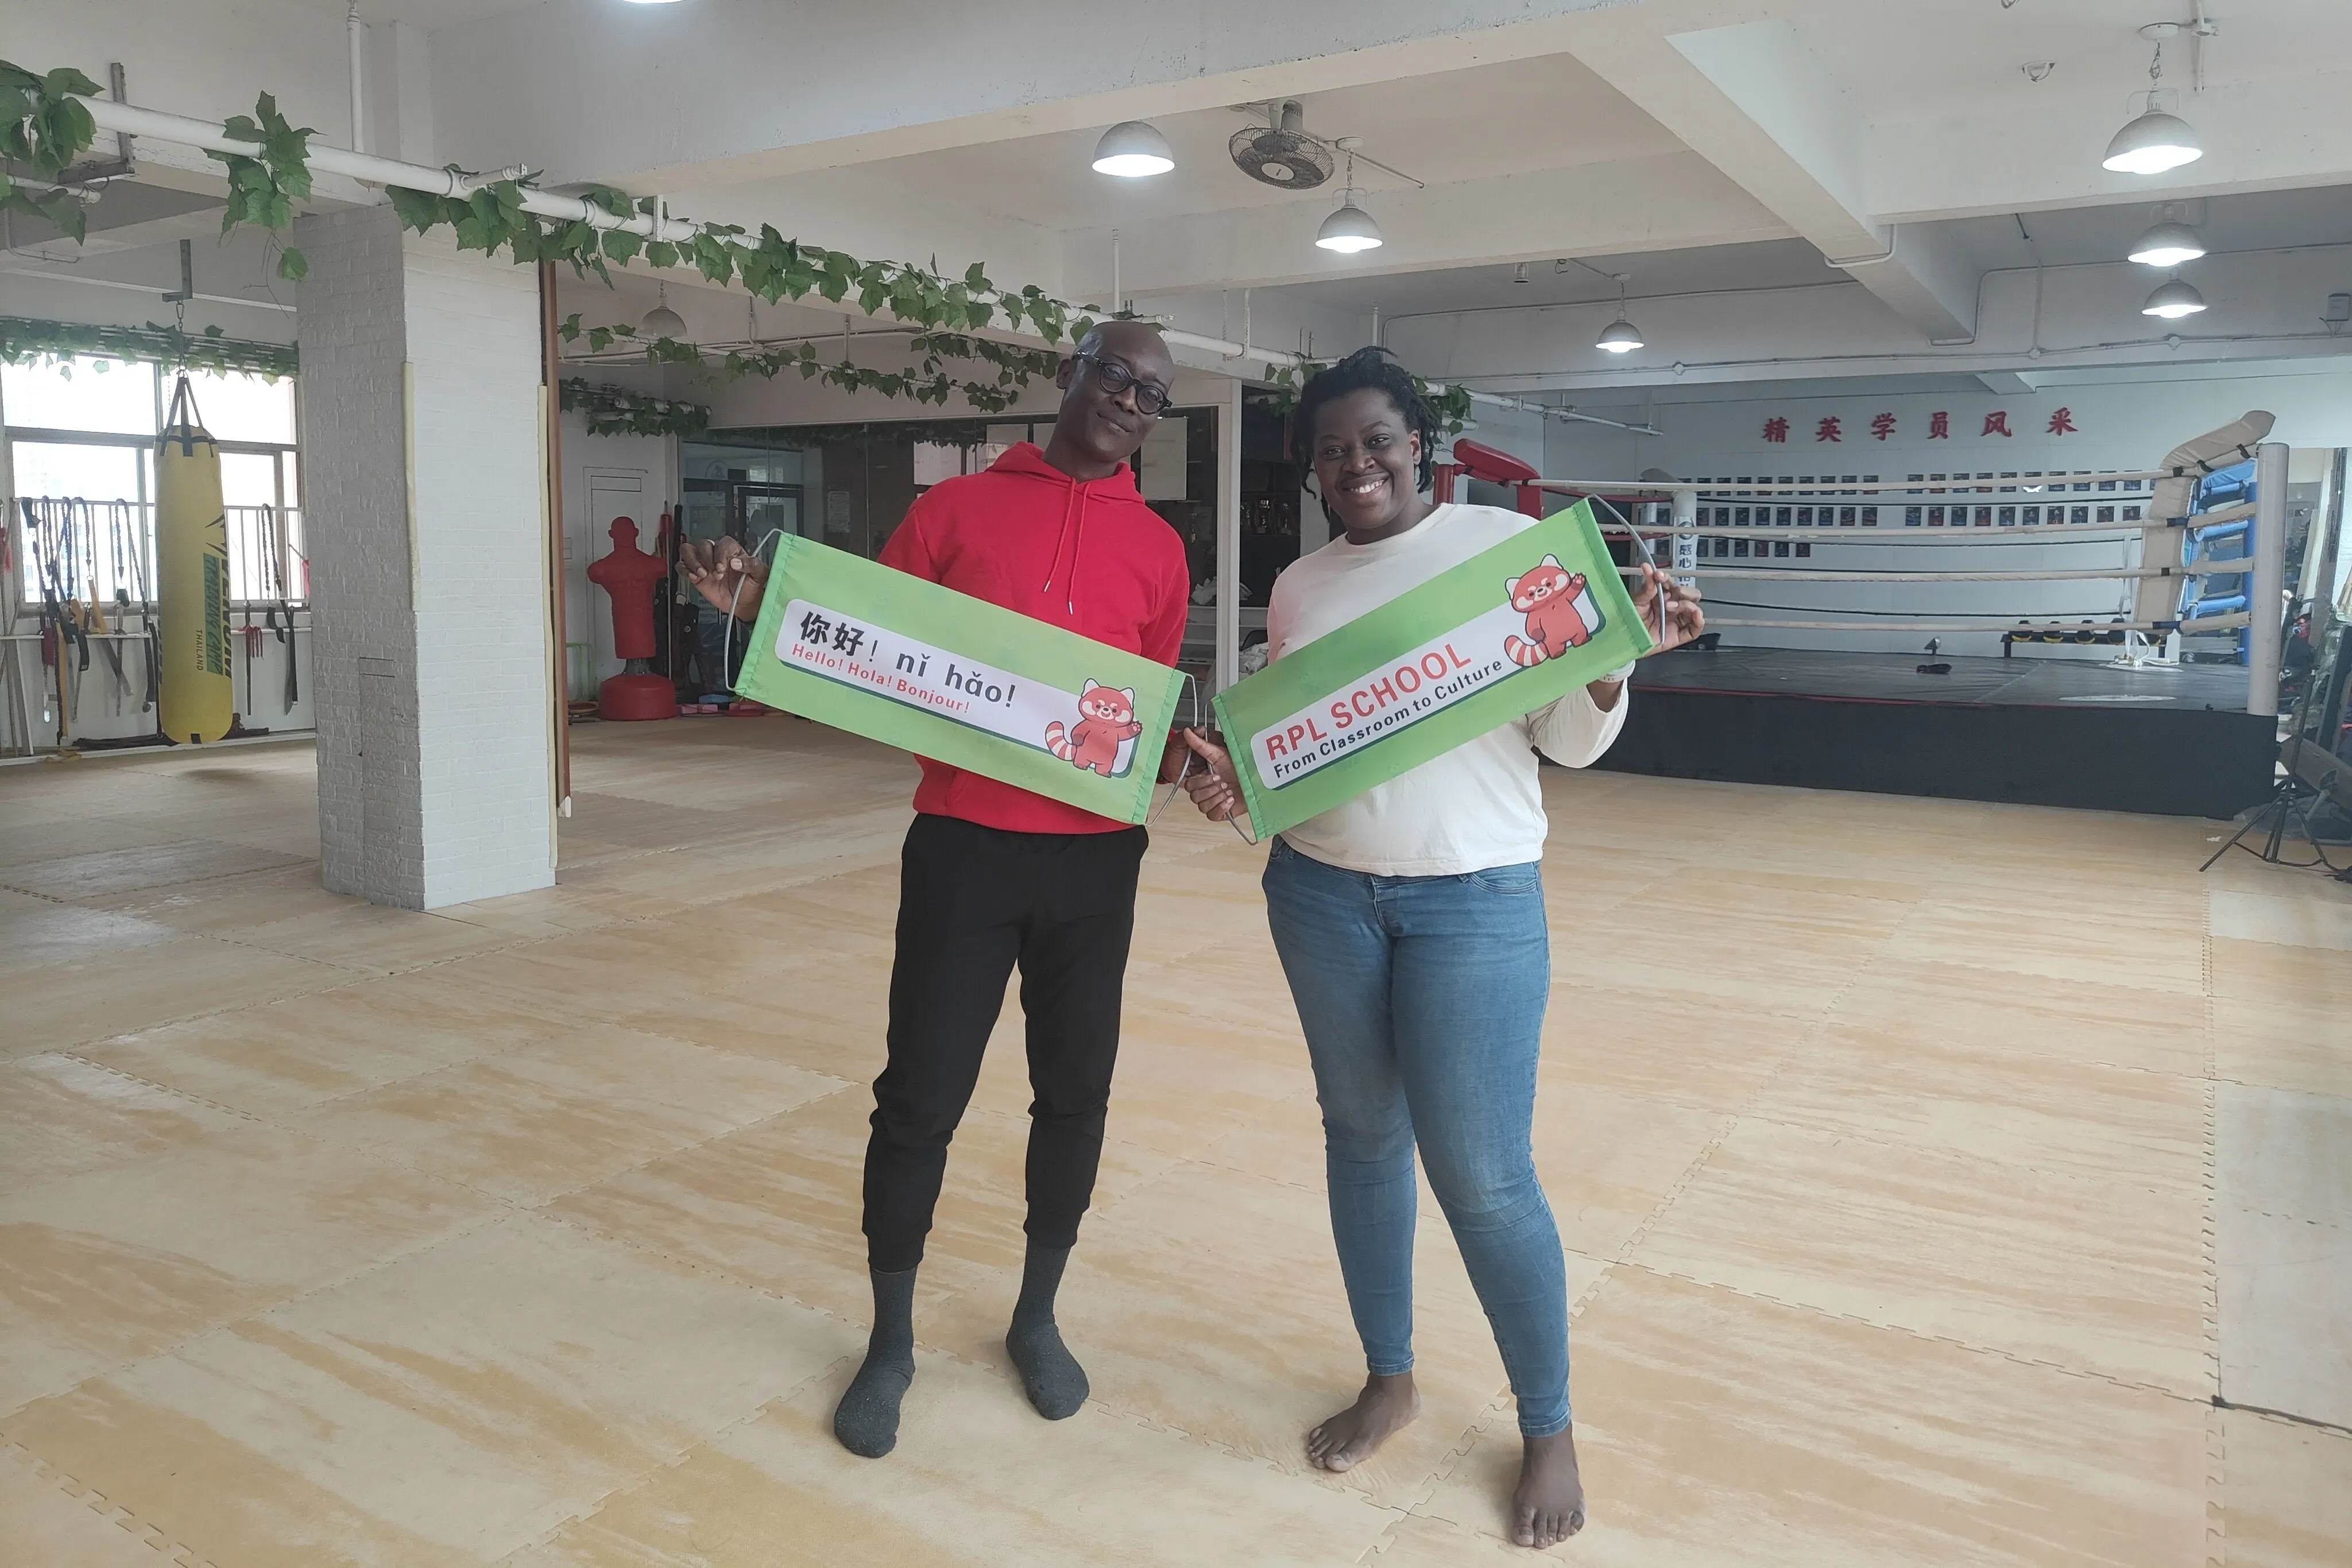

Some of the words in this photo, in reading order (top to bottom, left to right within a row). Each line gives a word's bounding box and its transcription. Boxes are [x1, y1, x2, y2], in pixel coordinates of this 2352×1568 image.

[1761, 406, 2078, 443] 精英学员风采
[196, 629, 204, 671] THAILAND
[792, 643, 844, 671] Hello!
[848, 662, 892, 687] Hola!
[896, 679, 970, 713] Bonjour!
[896, 653, 931, 677] nǐ
[1266, 717, 1328, 761] RPL
[1330, 643, 1472, 729] SCHOOL
[1274, 752, 1317, 779] From
[1320, 707, 1410, 756] Classroom
[1413, 697, 1432, 711] to
[1434, 661, 1502, 700] Culture
